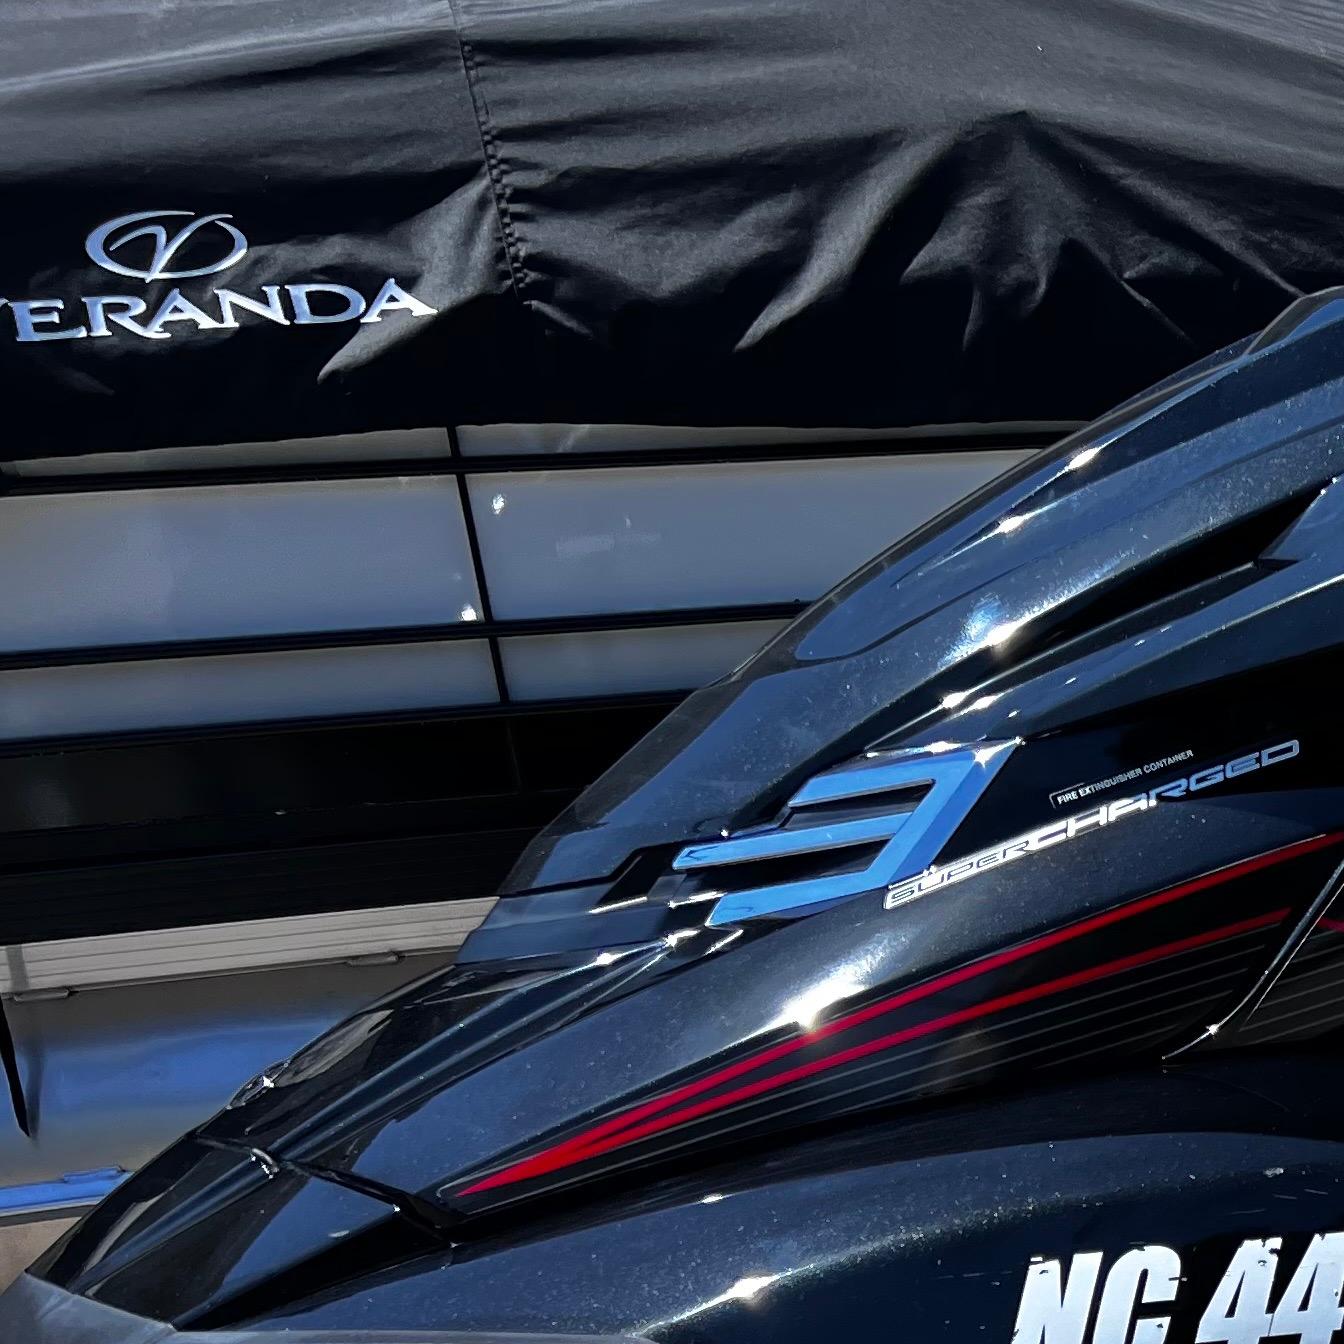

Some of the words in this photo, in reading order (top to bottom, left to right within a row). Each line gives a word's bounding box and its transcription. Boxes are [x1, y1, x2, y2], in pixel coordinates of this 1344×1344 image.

[0, 278, 438, 341] ERANDA
[1057, 792, 1079, 805] FIRE
[1078, 767, 1143, 797] EXTINGUISHER
[1143, 749, 1194, 774] CONTAINER
[884, 739, 1301, 910] SUPERCHARGED
